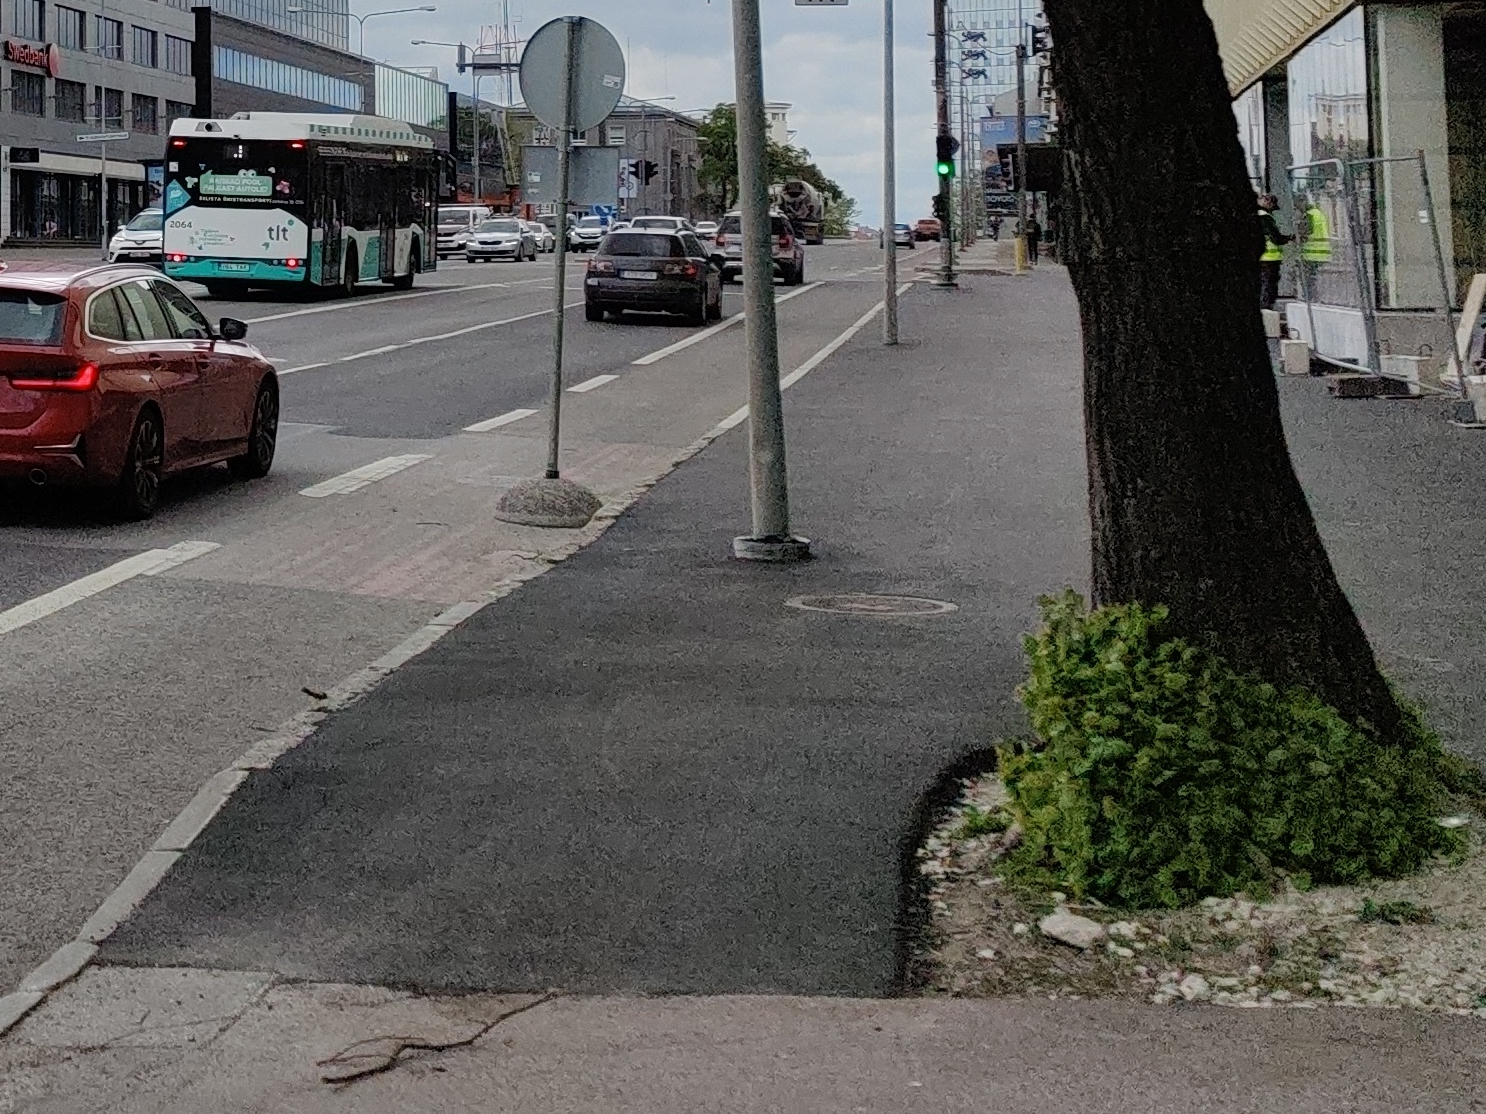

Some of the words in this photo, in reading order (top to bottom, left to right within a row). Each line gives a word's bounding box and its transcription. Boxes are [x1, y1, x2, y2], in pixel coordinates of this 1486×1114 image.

[7, 41, 48, 67] Swedbank
[169, 220, 193, 229] 2064
[267, 224, 289, 242] tlt
